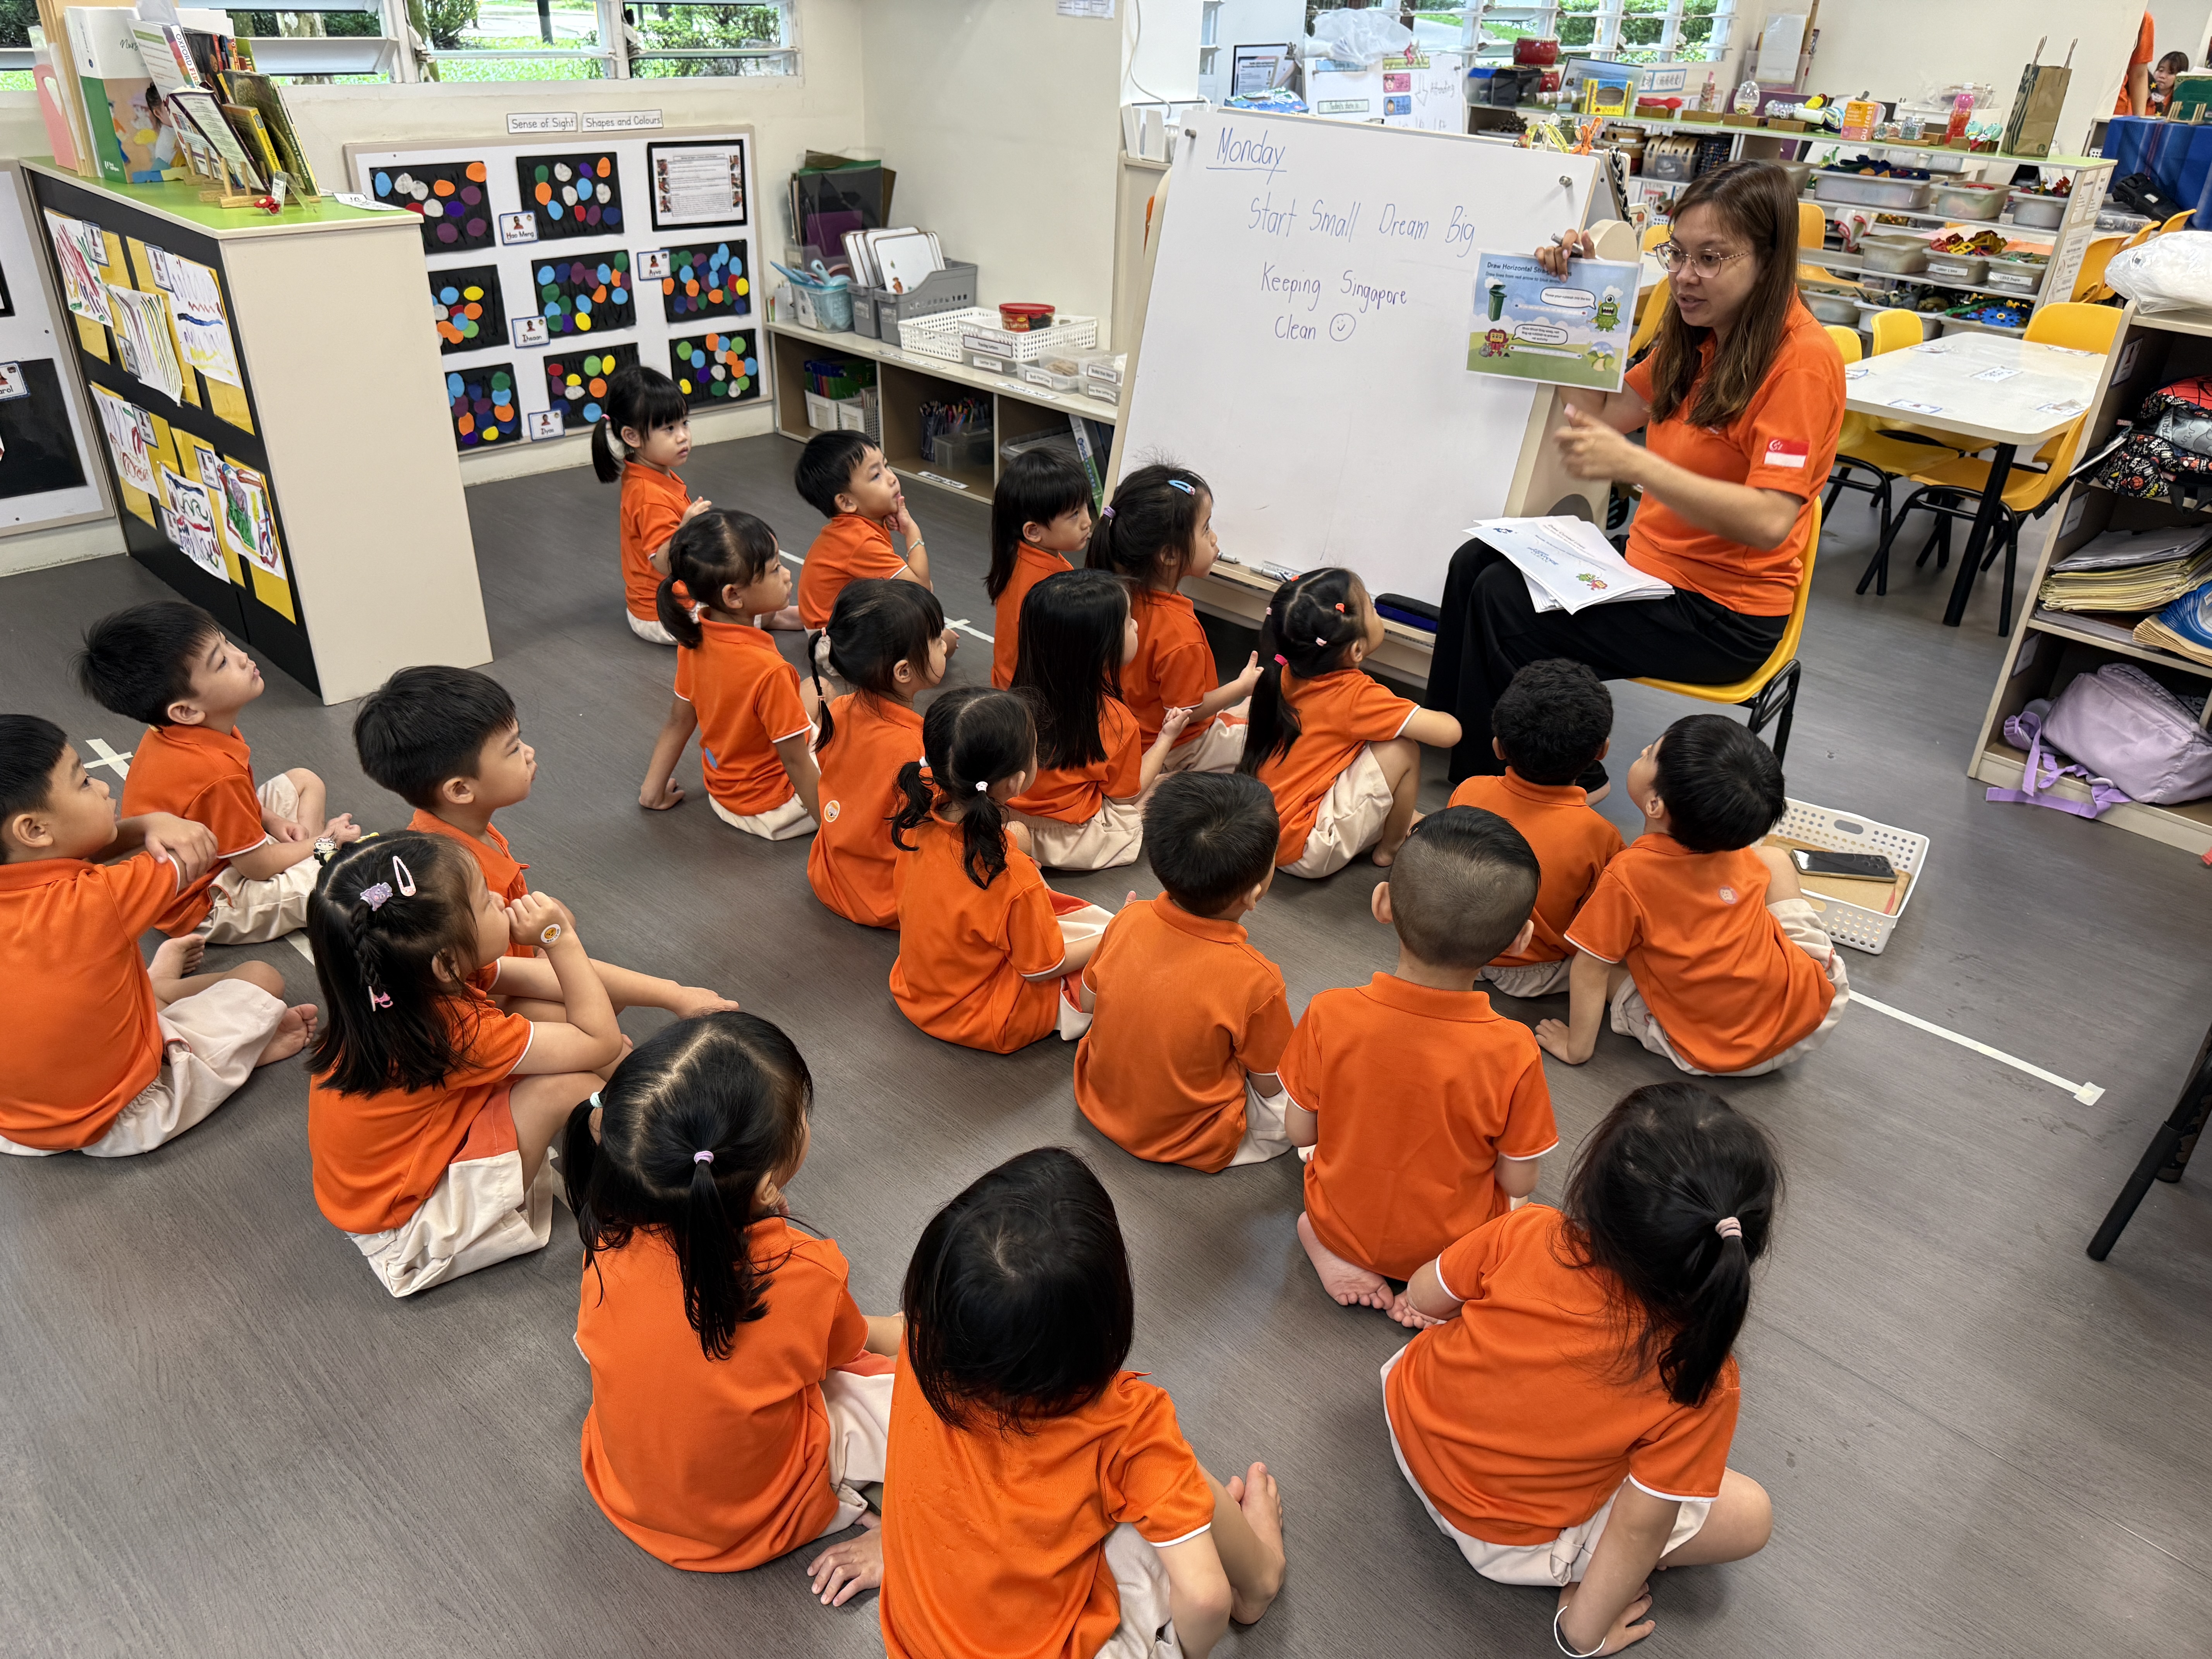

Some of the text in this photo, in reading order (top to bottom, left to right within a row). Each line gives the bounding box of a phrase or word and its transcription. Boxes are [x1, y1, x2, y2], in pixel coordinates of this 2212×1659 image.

[175, 33, 192, 66] OXFORD
[512, 118, 574, 130] Sense of Sight
[586, 116, 661, 129] Shapes and Colours
[1217, 127, 1286, 185] Monday
[1248, 191, 1475, 258] Start Small Dream Big
[1502, 264, 1532, 272] Horizontal
[1261, 262, 1407, 314] Keeping Singapore
[1275, 316, 1316, 340] Clean
[0, 385, 14, 394] arol
